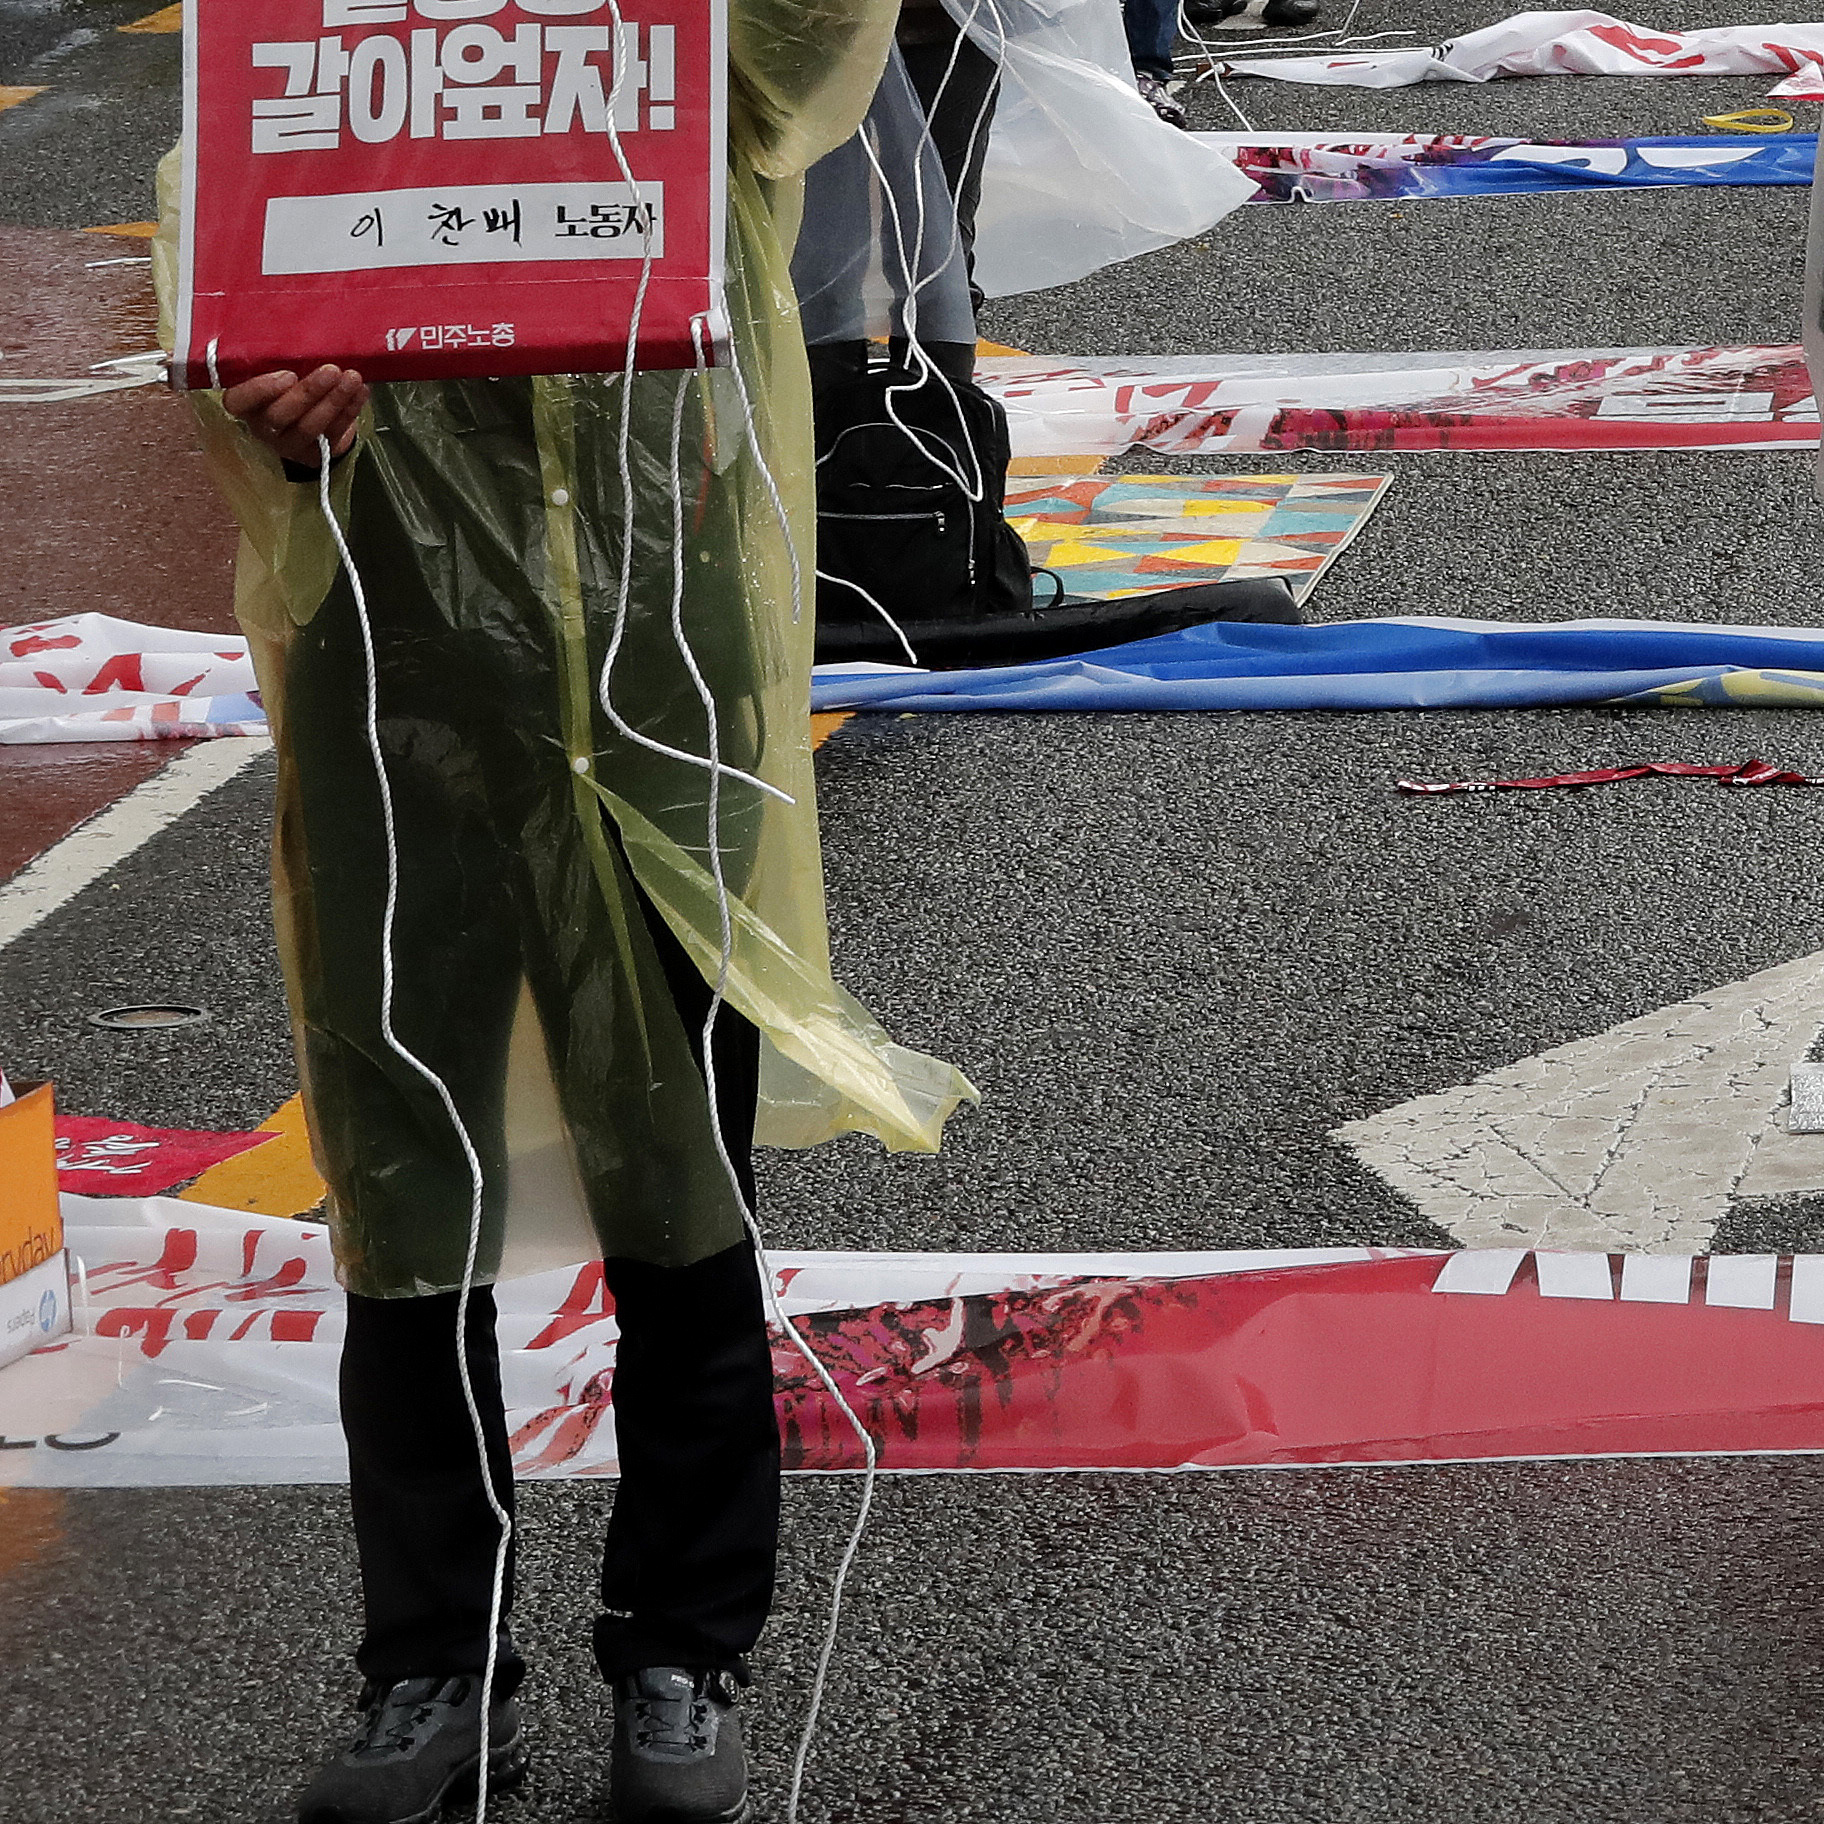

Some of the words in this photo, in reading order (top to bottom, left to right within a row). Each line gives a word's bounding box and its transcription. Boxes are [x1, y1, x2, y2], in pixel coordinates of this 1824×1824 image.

[250, 22, 677, 156] 갈아엎자!
[554, 200, 659, 244] 노동자
[419, 321, 517, 351] 민주노총
